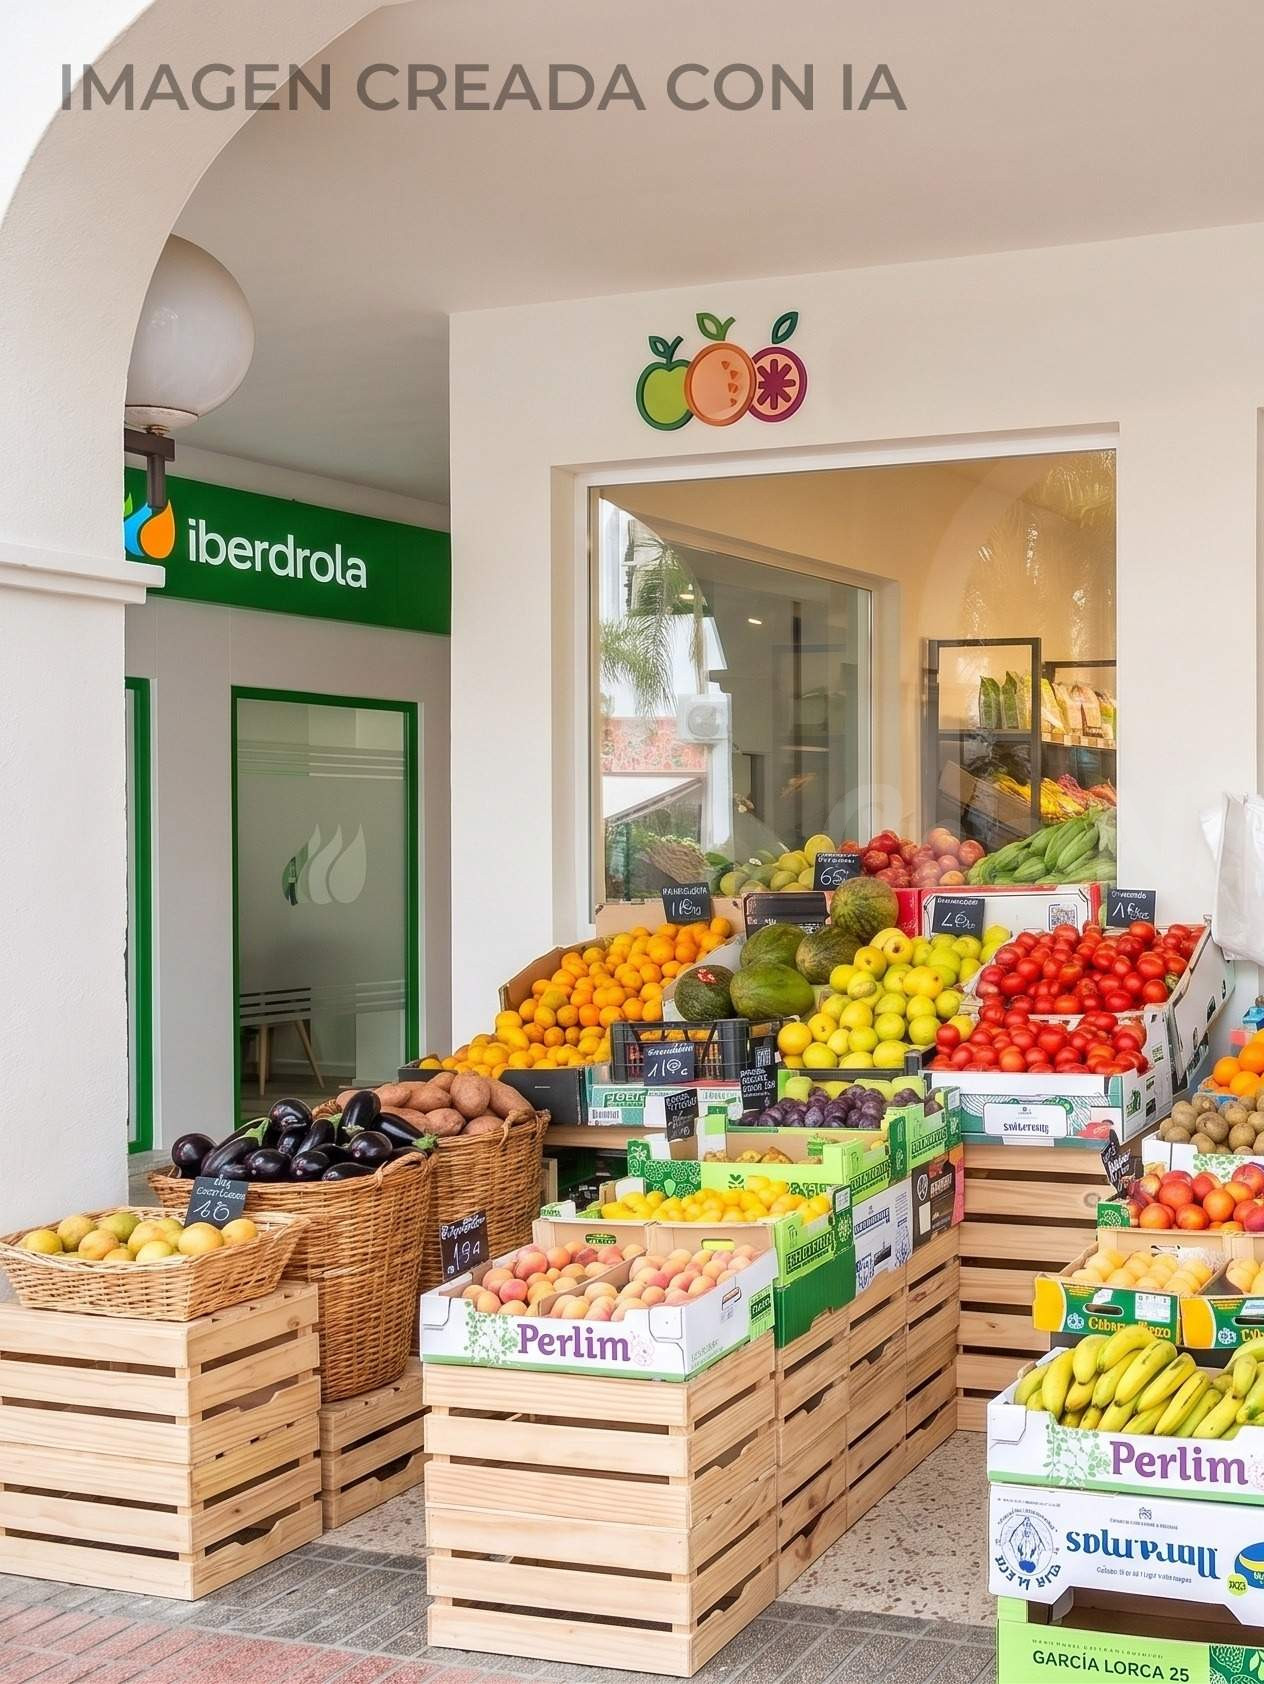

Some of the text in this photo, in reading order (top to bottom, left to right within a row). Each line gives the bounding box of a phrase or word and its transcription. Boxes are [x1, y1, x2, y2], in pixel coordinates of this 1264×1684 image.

[188, 518, 367, 588] iberdrola
[516, 1323, 631, 1362] Perlim
[1109, 1441, 1249, 1485] Perlim
[1032, 1650, 1190, 1682] GARCÍA LORCA 25
